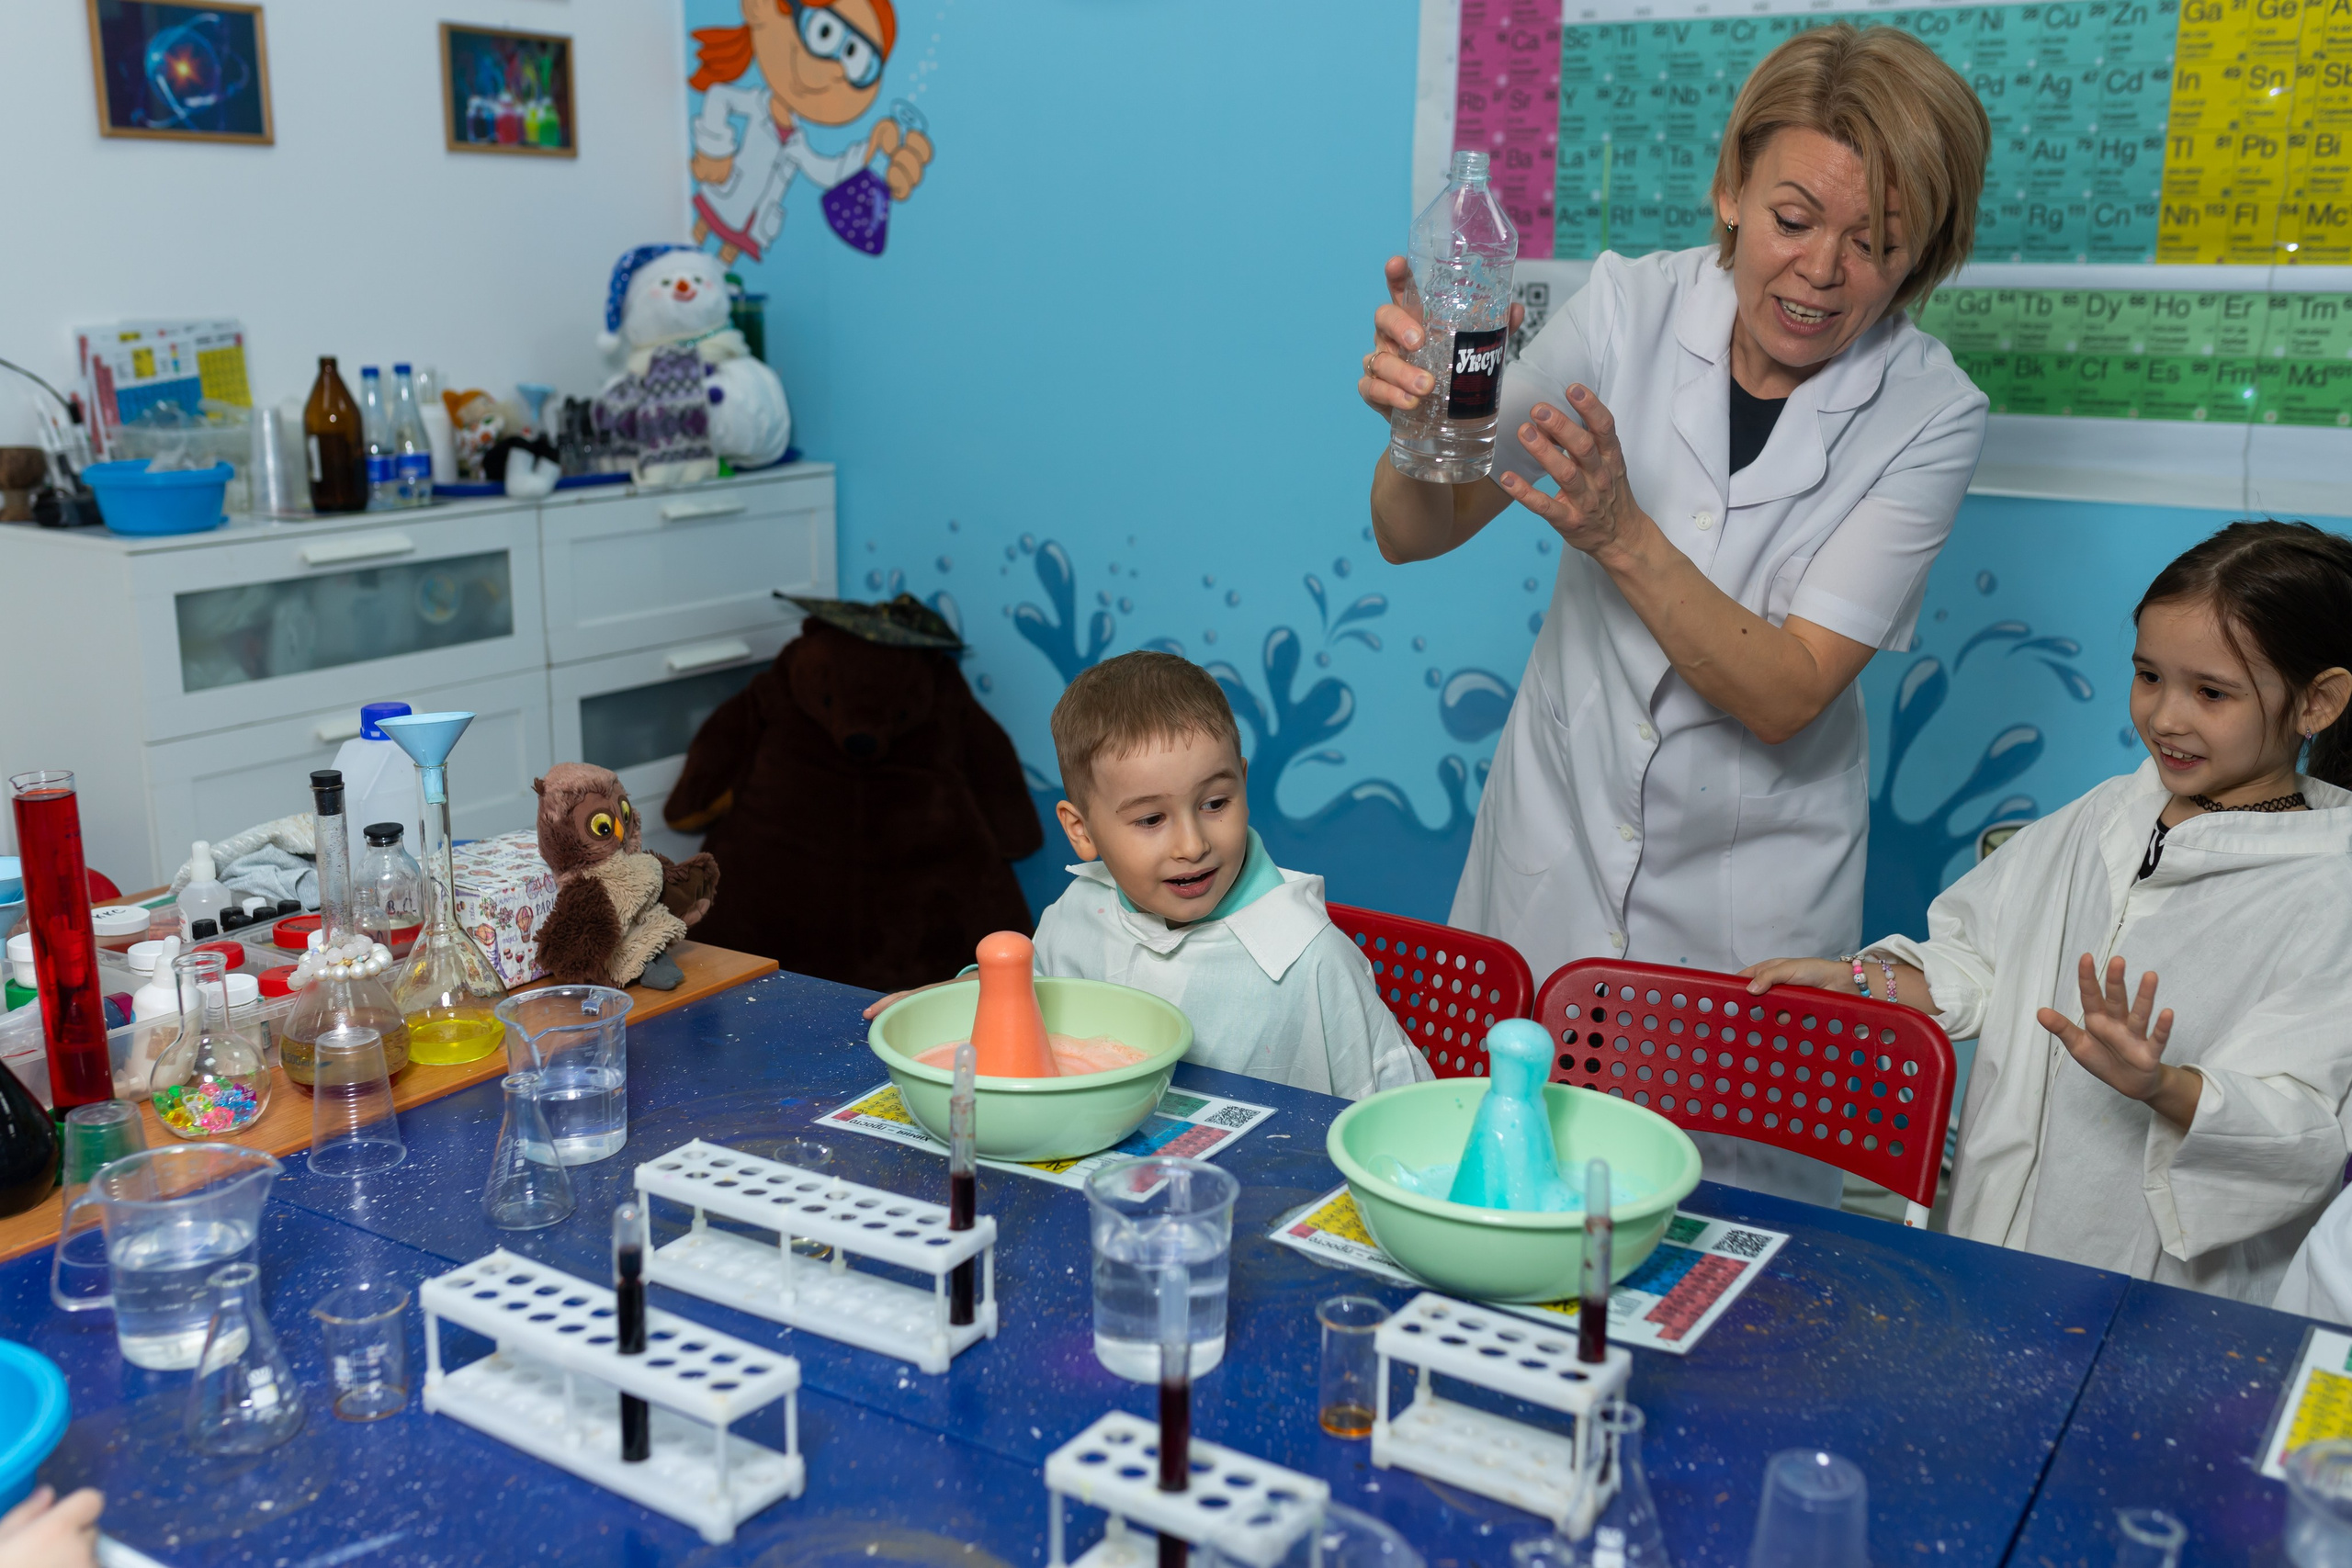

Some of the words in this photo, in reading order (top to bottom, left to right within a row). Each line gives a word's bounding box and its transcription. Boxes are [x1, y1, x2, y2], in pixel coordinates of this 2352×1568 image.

[1511, 29, 1540, 51] Ca
[1563, 26, 1591, 48] Sc
[1617, 25, 1637, 46] Ti
[1673, 22, 1691, 43] V
[1730, 19, 1758, 42] Cr
[1915, 11, 1951, 35] Co
[1980, 8, 2006, 31] Ni
[2045, 4, 2082, 28] Cu
[2113, 1, 2148, 25] Zn
[2184, 0, 2222, 23] Ga
[2256, 0, 2297, 19] Ge
[1510, 90, 1532, 111] Sr
[1562, 87, 1577, 108] Y
[1613, 86, 1636, 108] Zr
[1668, 85, 1702, 106] Nb
[1974, 73, 2007, 97] Pd
[2038, 73, 2073, 103] Ag
[2107, 69, 2144, 94] Cd
[2177, 69, 2200, 91] In
[2248, 64, 2286, 90] Sn
[1506, 148, 1533, 169] Ba
[1558, 149, 1585, 168] La
[1612, 148, 1637, 167] Hf
[1668, 145, 1693, 167] Ta
[2031, 140, 2066, 162] Au
[2100, 139, 2137, 167] Hg
[2173, 136, 2194, 159] Tl
[2242, 134, 2278, 158] Pb
[2314, 133, 2342, 157] Bi
[1558, 207, 1584, 226] Ac
[1611, 205, 1634, 226] Rf
[1665, 205, 1697, 227] Db
[2028, 203, 2064, 233] Rg
[2094, 202, 2132, 228] Cn
[2164, 203, 2200, 226] Nh
[2307, 202, 2348, 227] Mc
[1955, 290, 1992, 316] Gd
[2022, 293, 2053, 317] Tb
[2086, 292, 2123, 322] Dy
[2154, 294, 2192, 319] Ho
[2224, 295, 2255, 319] Er
[2300, 296, 2338, 320] Tm
[1456, 345, 1504, 377] Уксус
[2015, 355, 2045, 379] Bk
[2080, 356, 2109, 381] Cf
[2147, 358, 2181, 384] Es
[2216, 361, 2256, 384] Fm
[2287, 364, 2329, 388] Md
